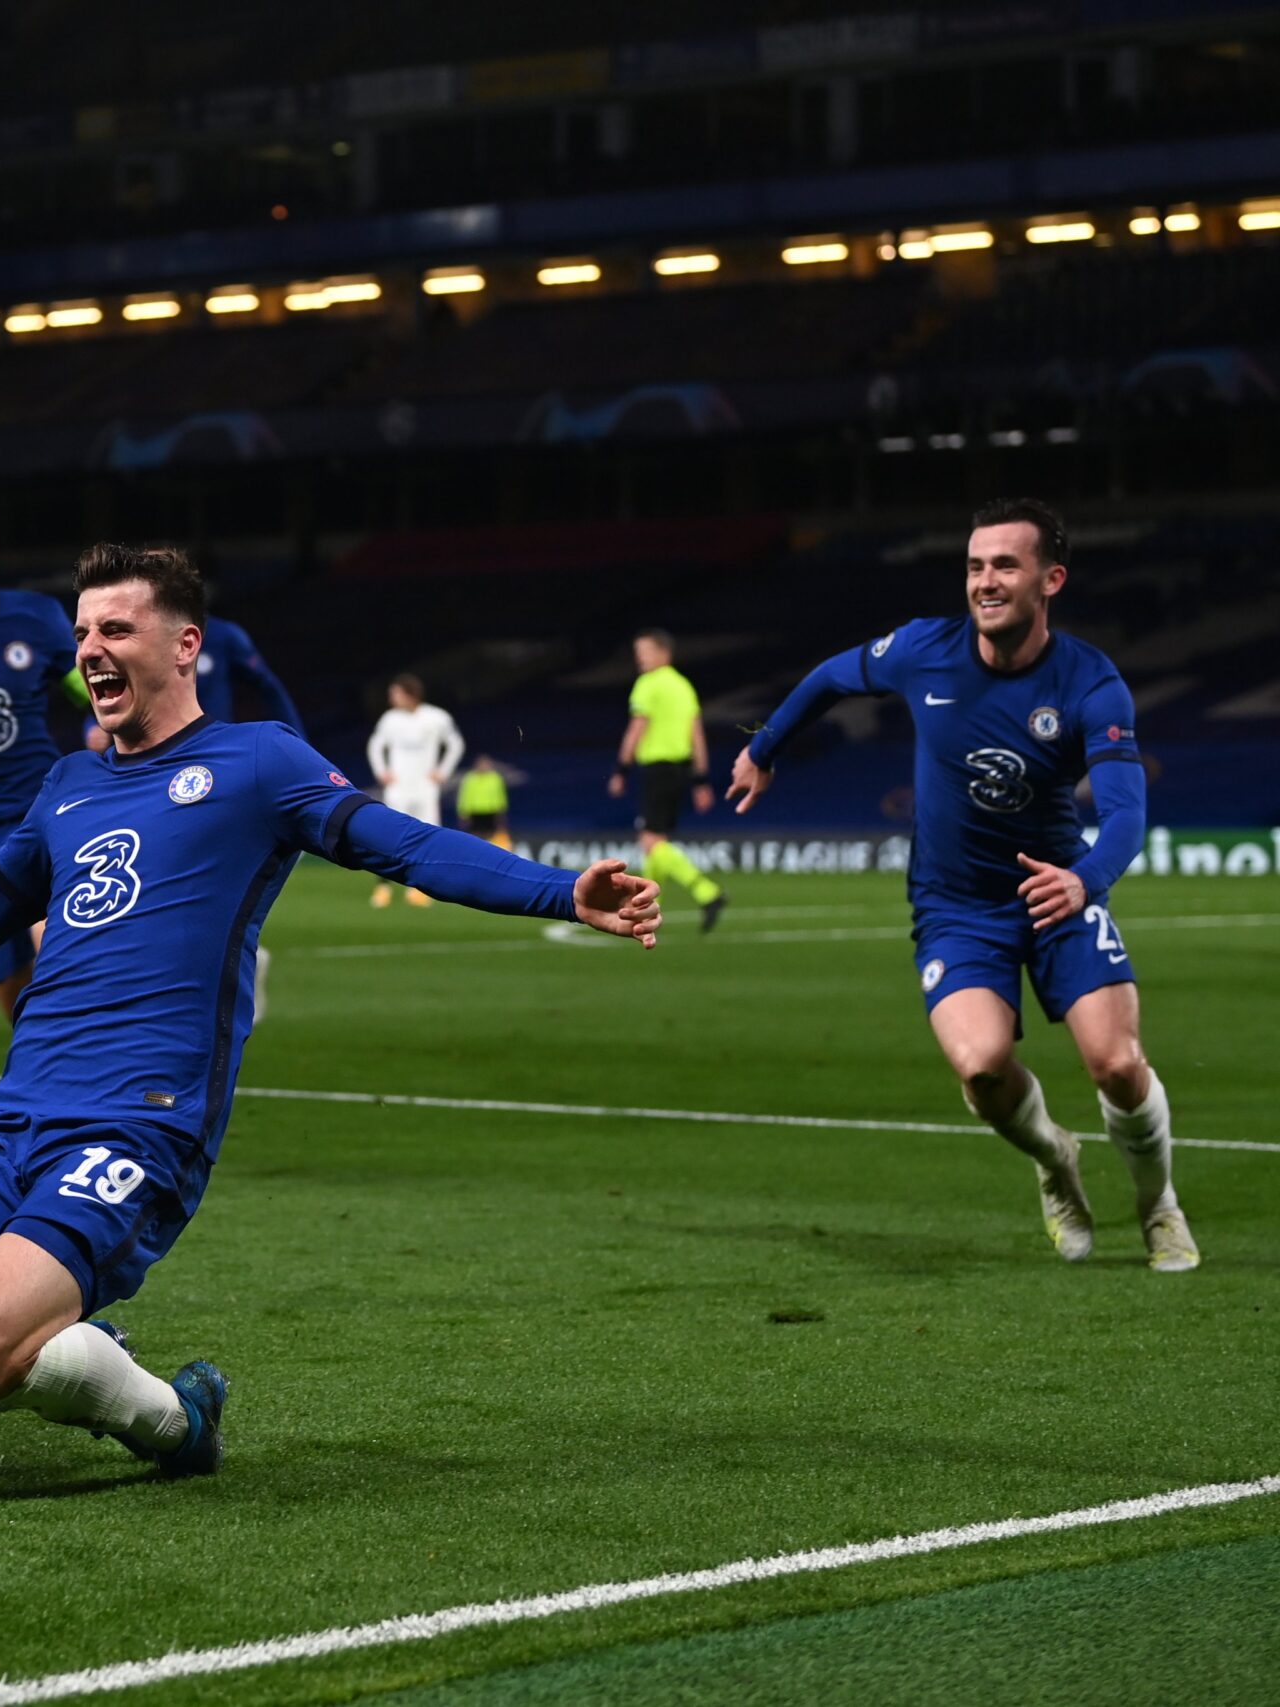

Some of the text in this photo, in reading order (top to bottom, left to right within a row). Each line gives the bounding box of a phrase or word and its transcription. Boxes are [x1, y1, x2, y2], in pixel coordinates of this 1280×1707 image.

[966, 747, 1034, 814] 3
[63, 828, 141, 929] 3
[740, 840, 873, 874] LEAGUE
[60, 1146, 146, 1205] 19
